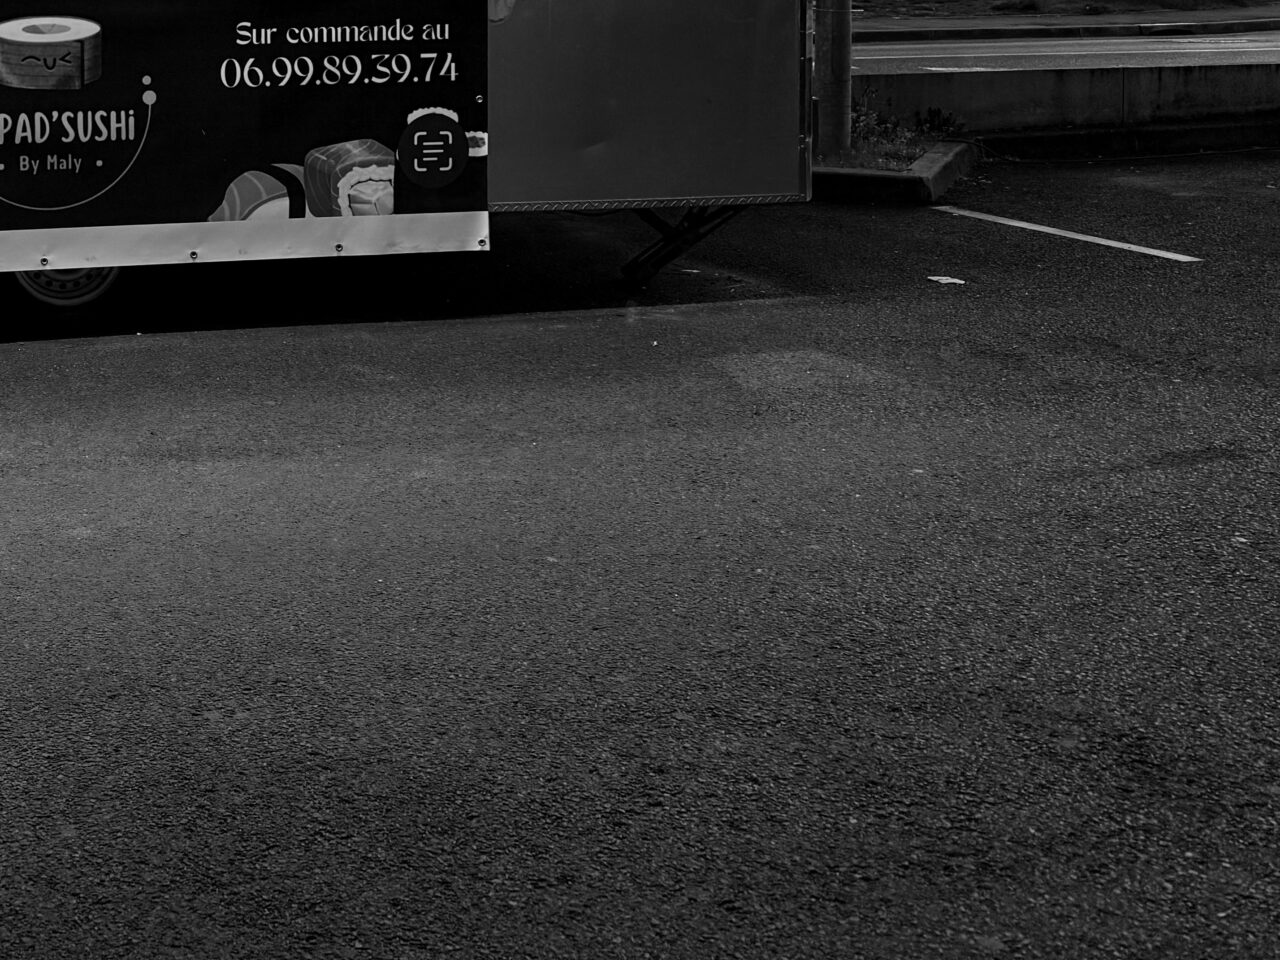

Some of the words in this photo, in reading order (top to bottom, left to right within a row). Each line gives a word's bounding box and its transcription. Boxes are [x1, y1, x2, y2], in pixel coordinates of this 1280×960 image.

[236, 21, 277, 45] Sur
[286, 18, 414, 44] commande
[422, 23, 449, 40] au
[220, 52, 456, 88] 06.99.89.39.74
[19, 155, 40, 175] By
[47, 154, 82, 173] Maly
